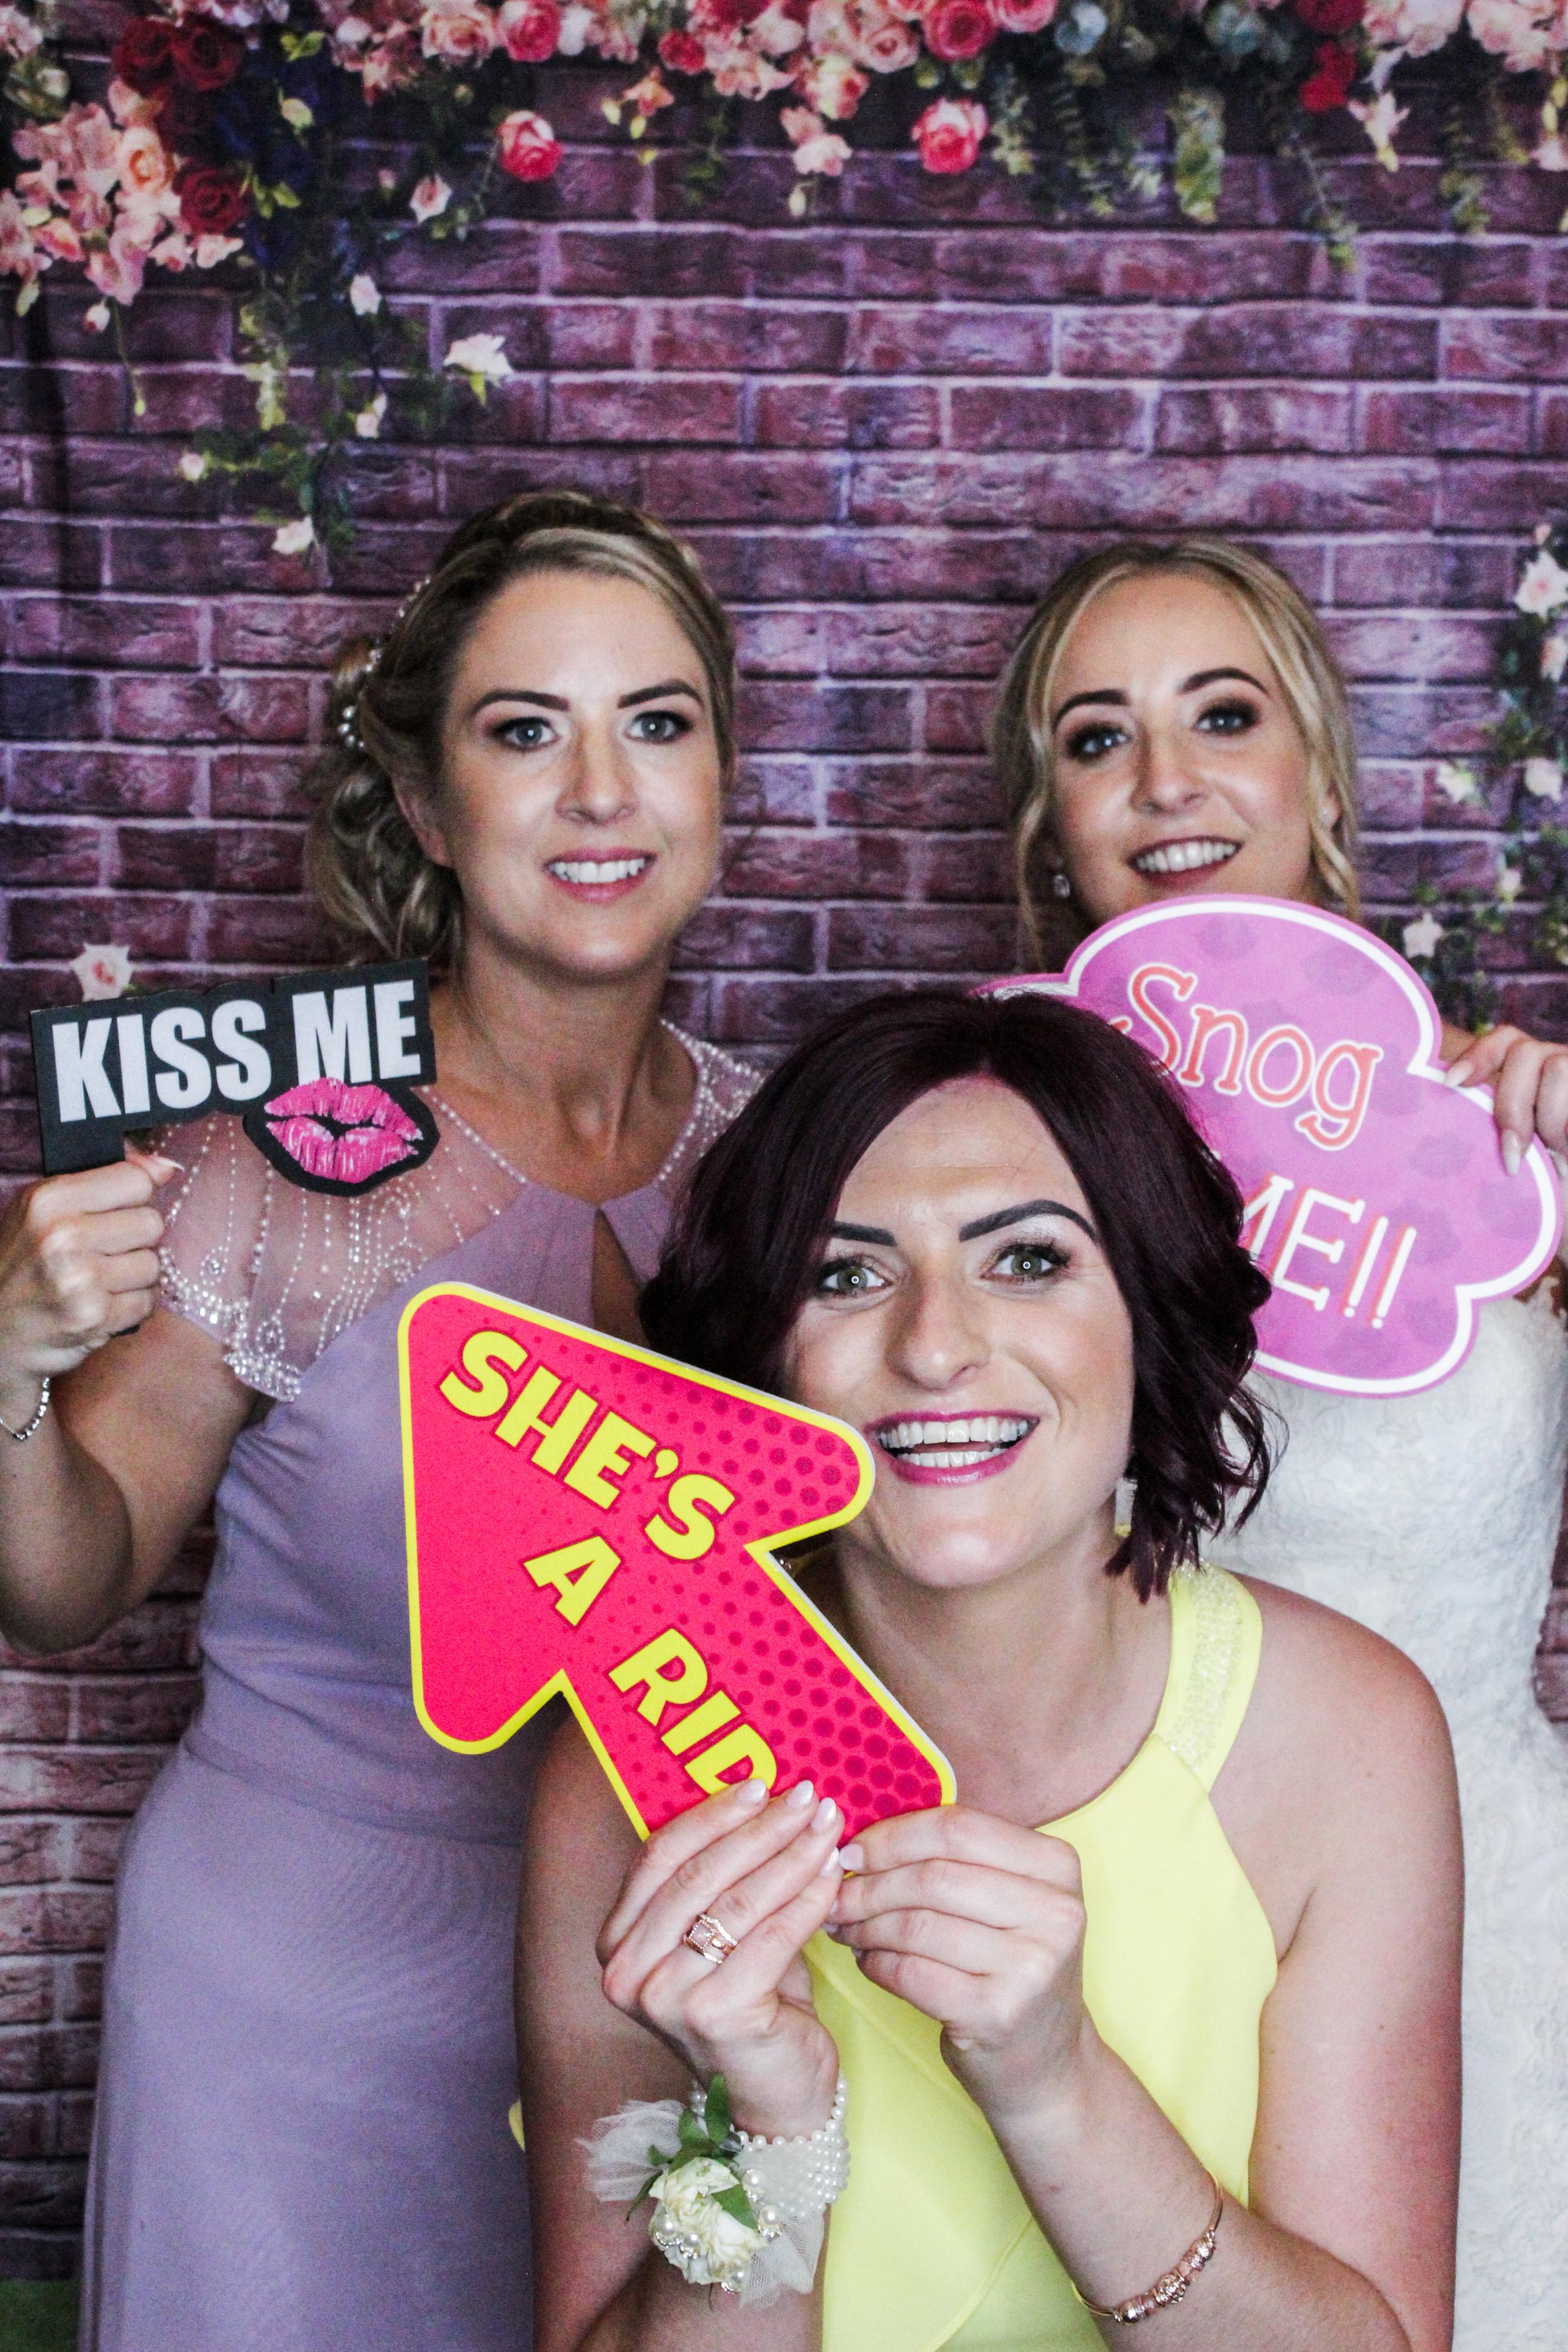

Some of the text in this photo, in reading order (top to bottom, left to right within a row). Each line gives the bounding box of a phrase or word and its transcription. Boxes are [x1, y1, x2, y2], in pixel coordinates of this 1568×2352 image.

[52, 979, 421, 1122] KISS ME
[1110, 962, 1384, 1151] Snog
[439, 1329, 736, 1561] SHE'S
[523, 1535, 621, 1627] A
